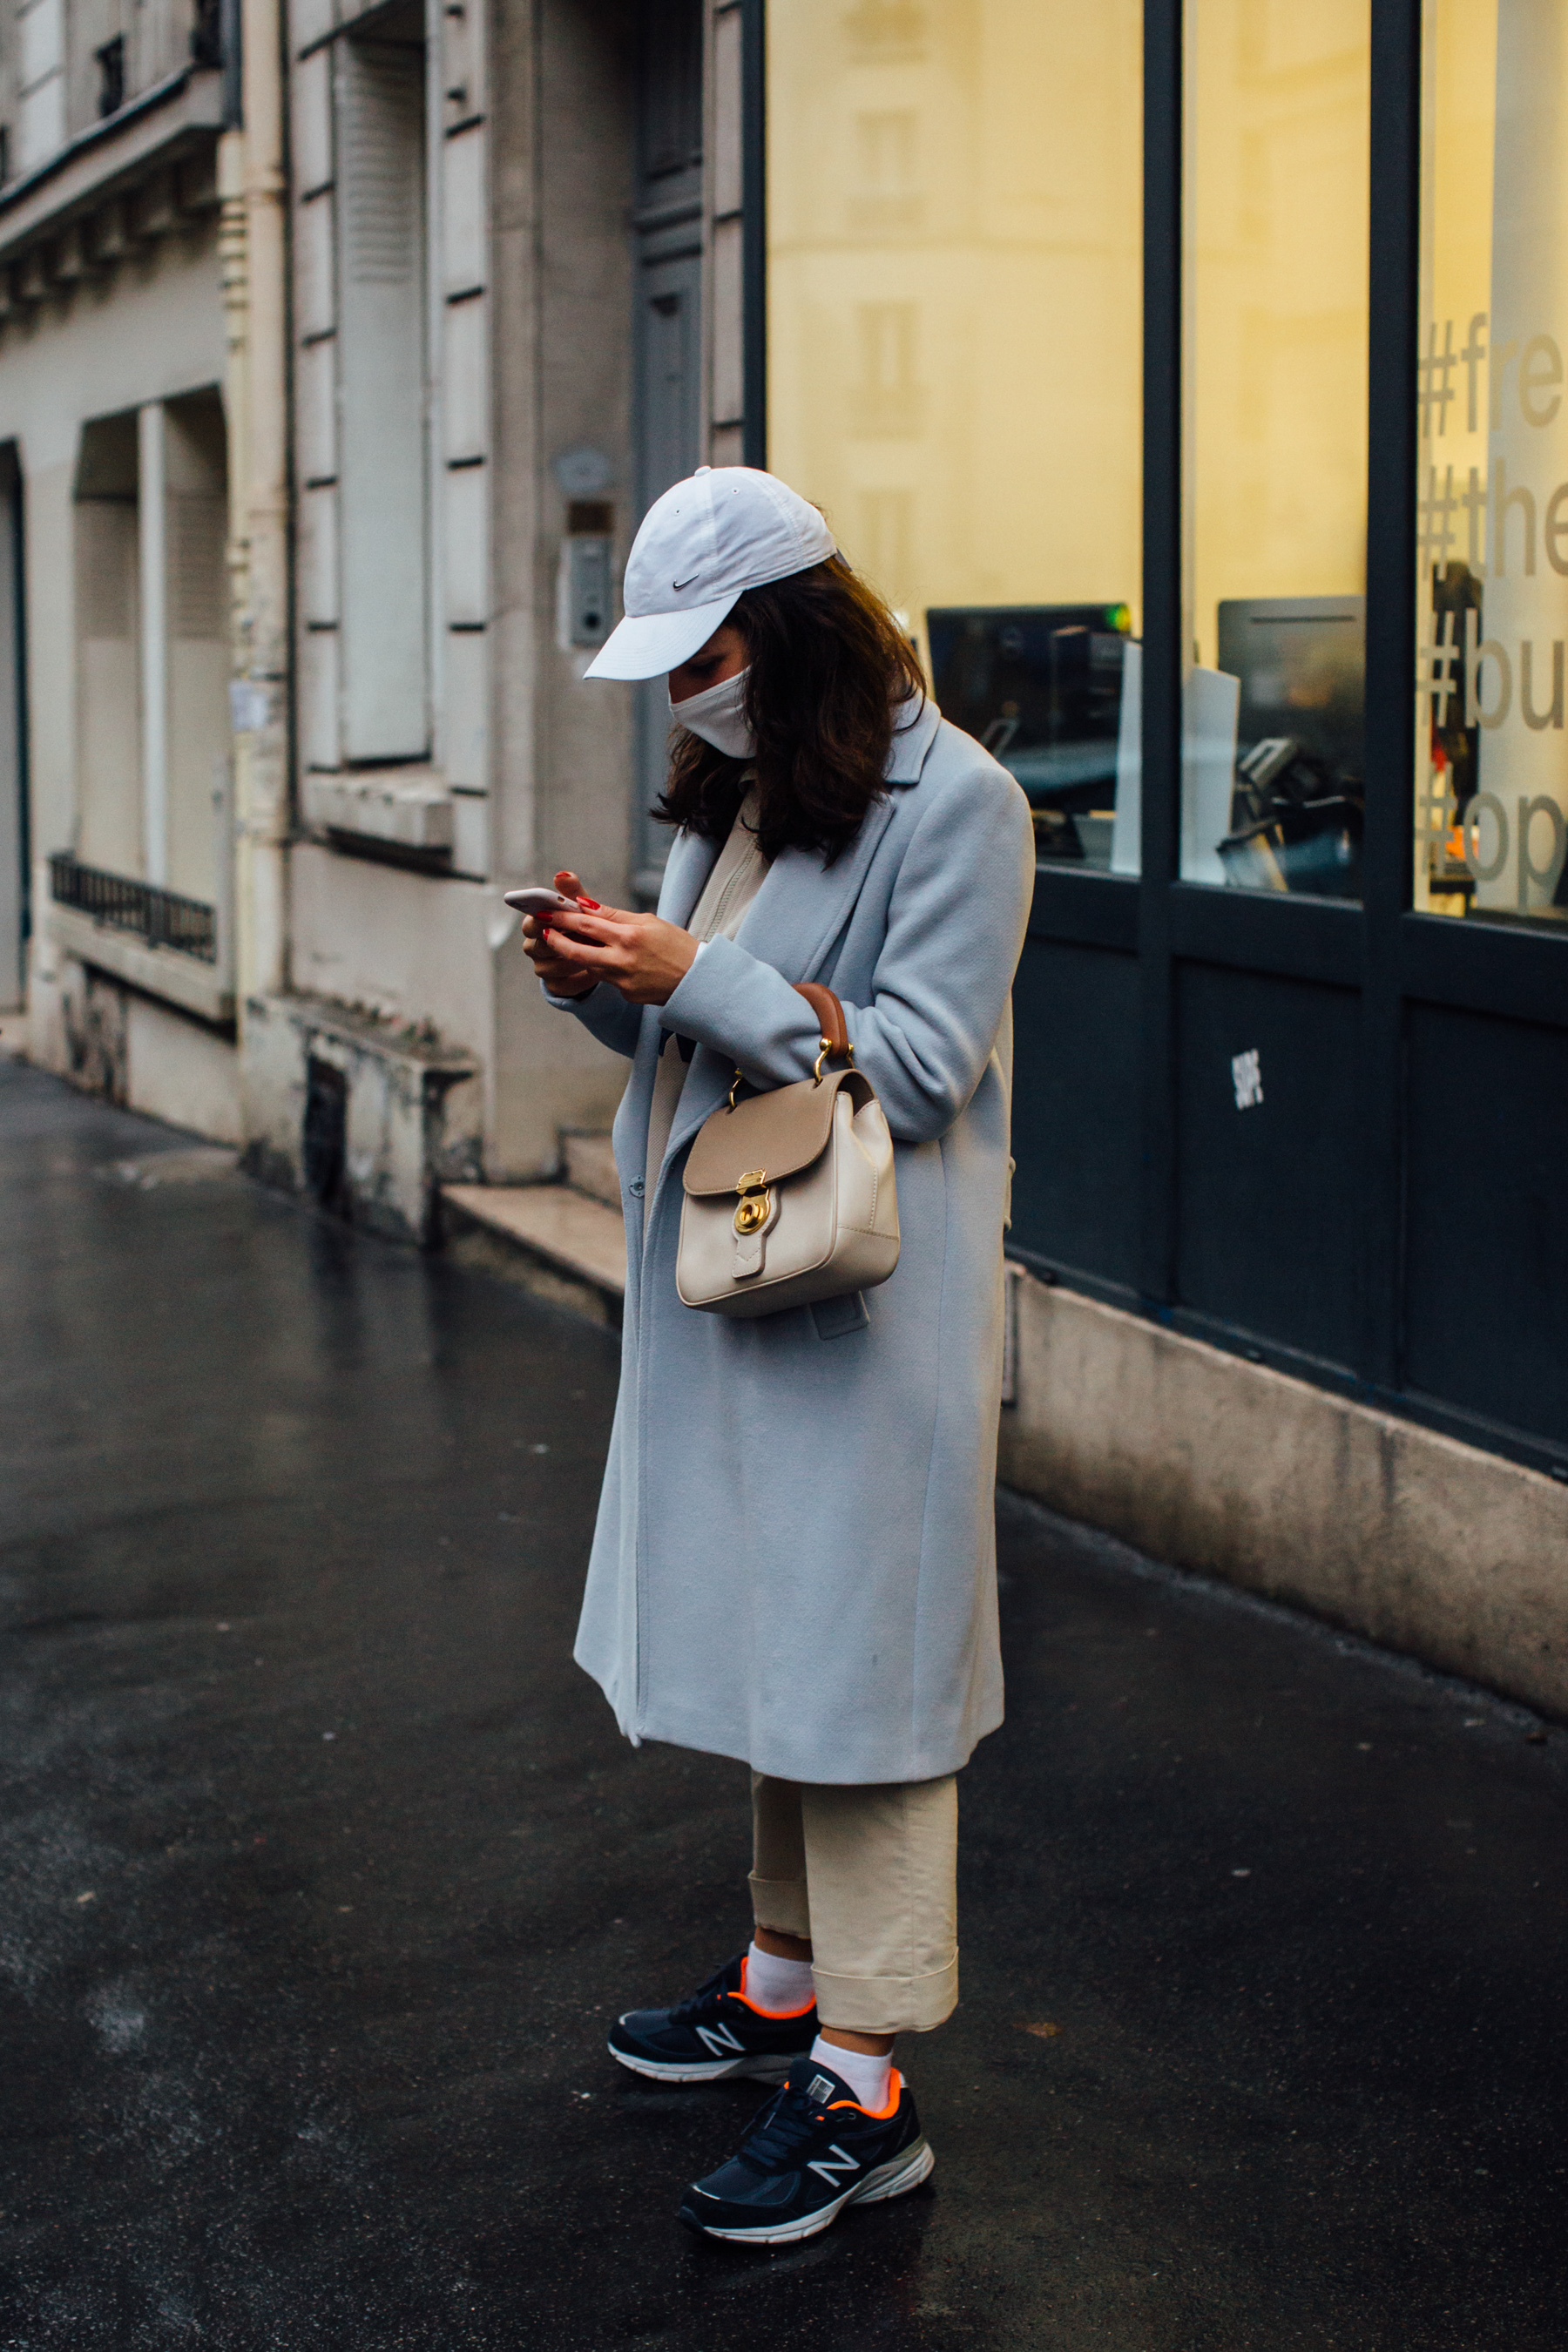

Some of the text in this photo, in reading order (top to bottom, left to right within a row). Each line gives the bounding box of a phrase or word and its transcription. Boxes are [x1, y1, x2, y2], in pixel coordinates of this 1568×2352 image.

[1418, 312, 1564, 437] #fre
[1417, 456, 1568, 582] #the
[1416, 608, 1565, 730] #bu
[1415, 762, 1567, 916] #op
[696, 2023, 746, 2056] N
[807, 2144, 861, 2187] N
